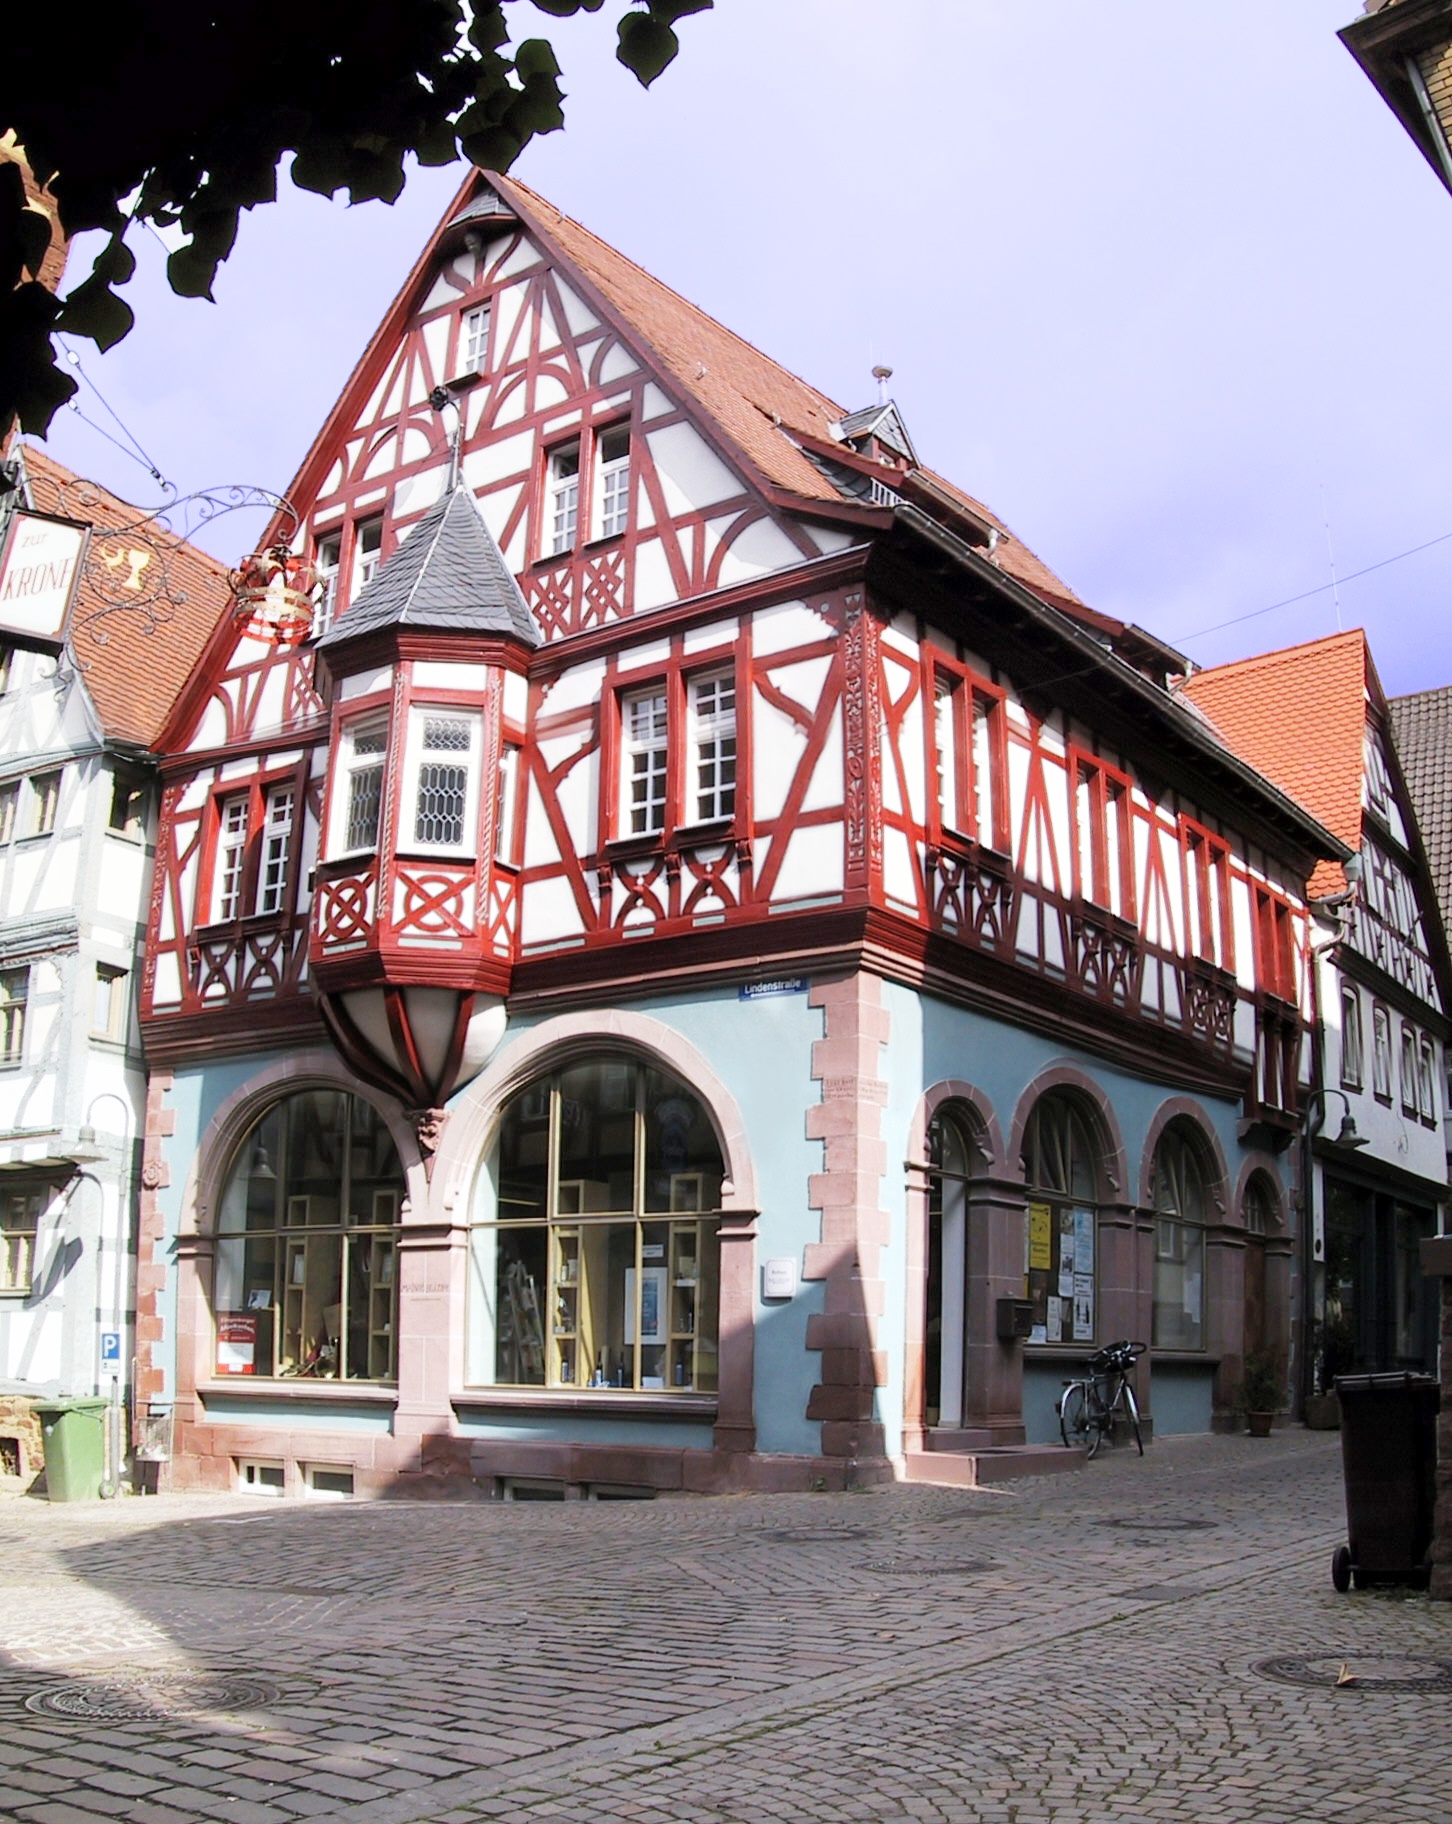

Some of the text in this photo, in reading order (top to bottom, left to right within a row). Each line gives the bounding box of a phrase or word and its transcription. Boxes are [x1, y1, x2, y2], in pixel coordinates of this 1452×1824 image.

[22, 533, 49, 548] zur
[3, 556, 75, 601] KRONE
[744, 978, 801, 994] Lindenstraße
[103, 1335, 117, 1358] P
